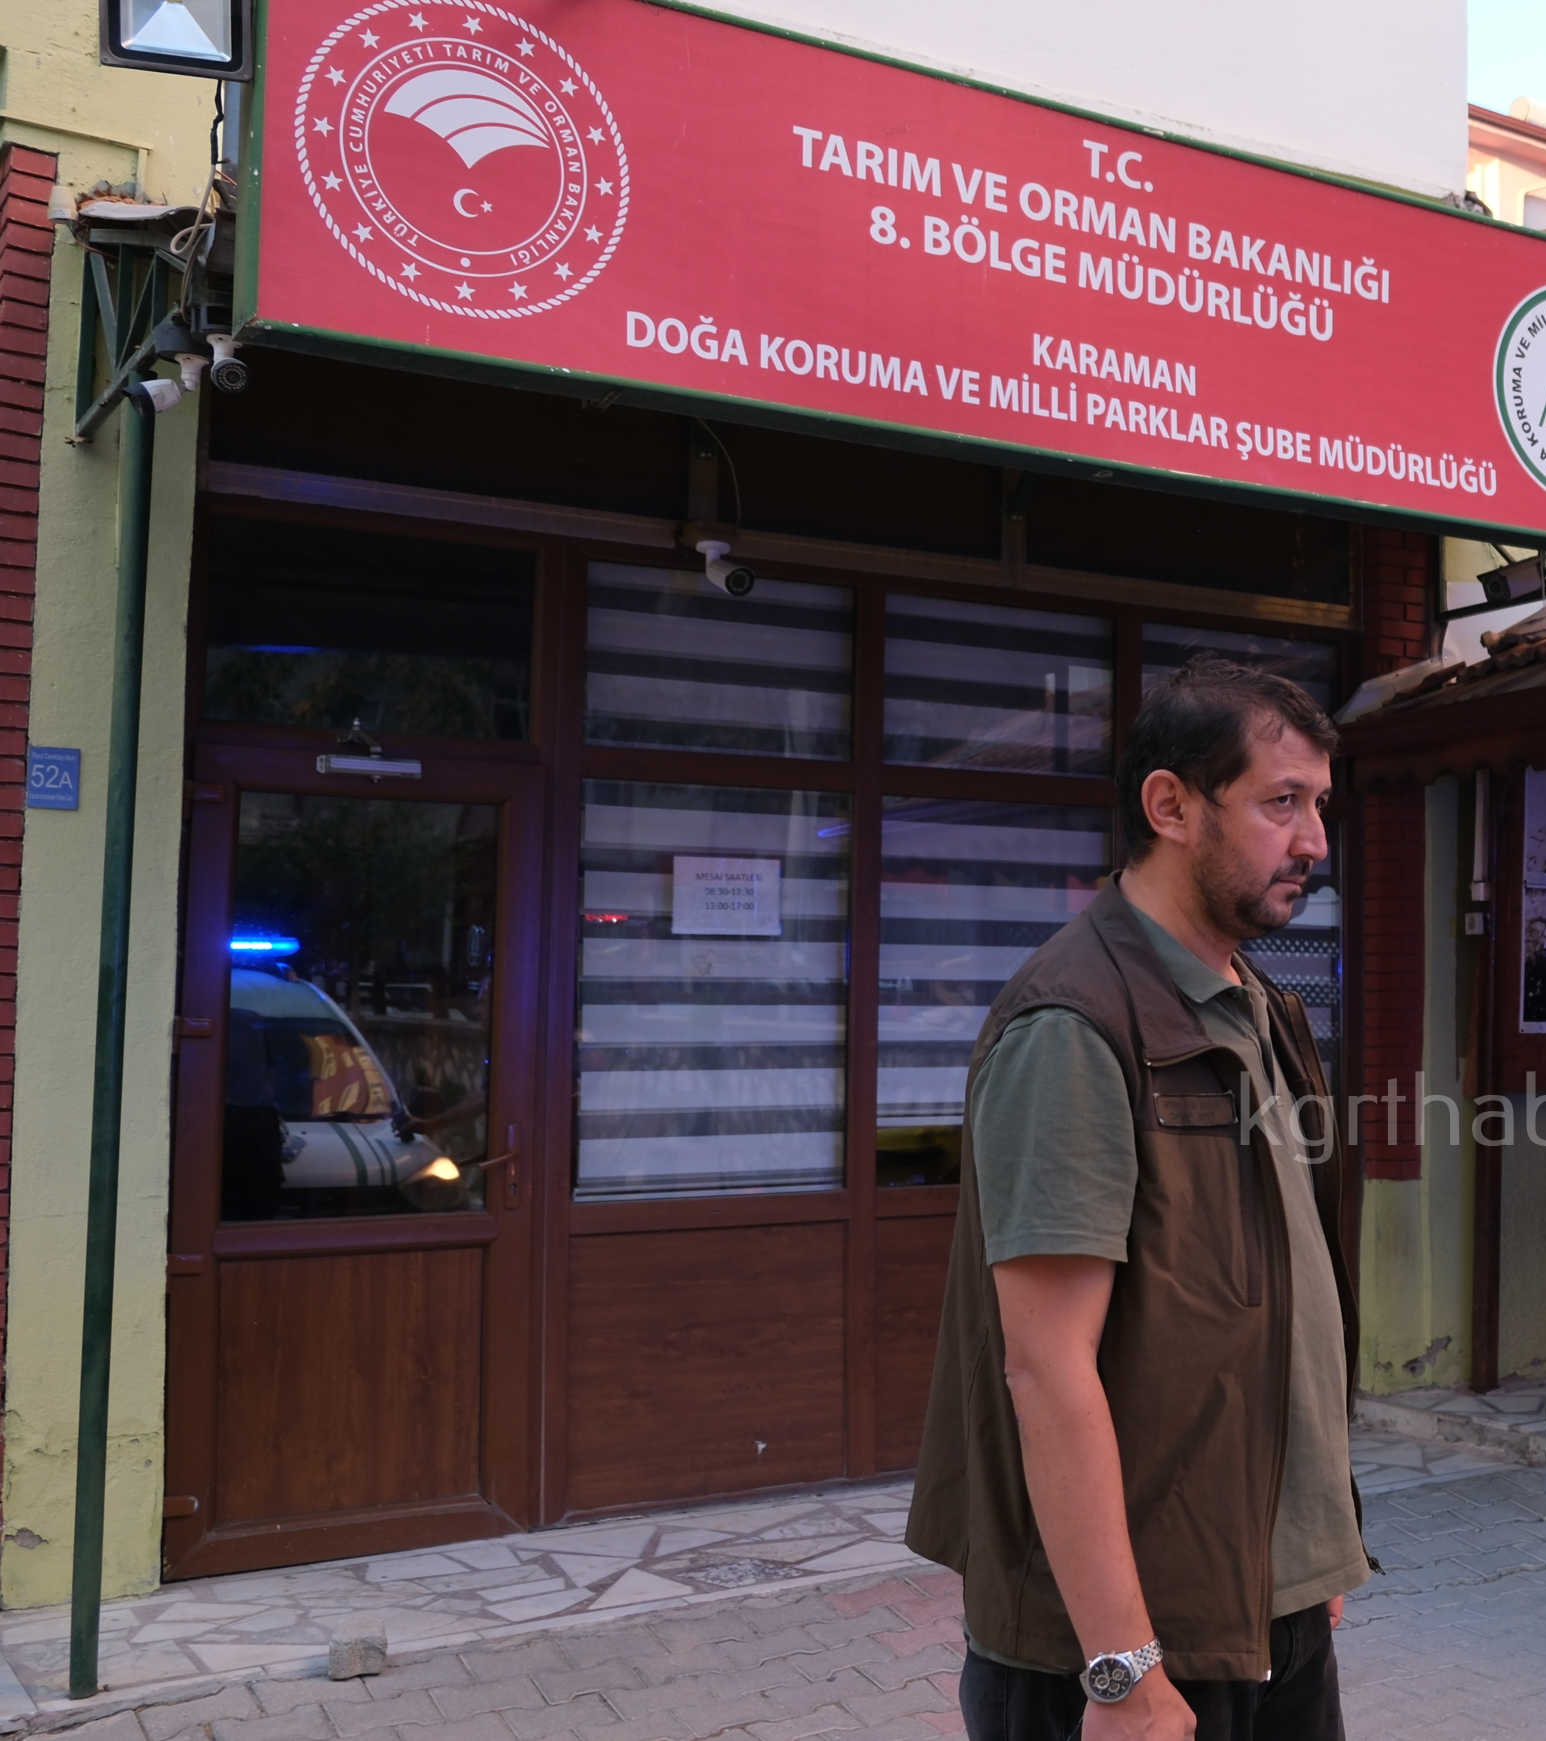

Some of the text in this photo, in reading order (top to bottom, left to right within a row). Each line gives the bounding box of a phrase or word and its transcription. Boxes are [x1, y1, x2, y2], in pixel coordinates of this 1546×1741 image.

[349, 42, 582, 266] TÜRKİYE CUMHURİYETİ TARIM VE ORMAN BAKANLIĞI
[1083, 139, 1154, 192] T.C.
[793, 125, 1389, 304] TARIM VE ORMAN BAKANLIĞI
[869, 206, 1333, 341] 8. BÖLGE MÜDÜRLÜĞÜ
[1032, 333, 1197, 396] KARAMAN
[1515, 337, 1531, 359] VE
[626, 310, 1497, 496] DOĞA KORUMA VE MİLLİ PARKLAR ŞUBE MÜDÜRLÜĞÜ
[1512, 366, 1539, 447] KORUMA
[31, 764, 73, 789] 52A
